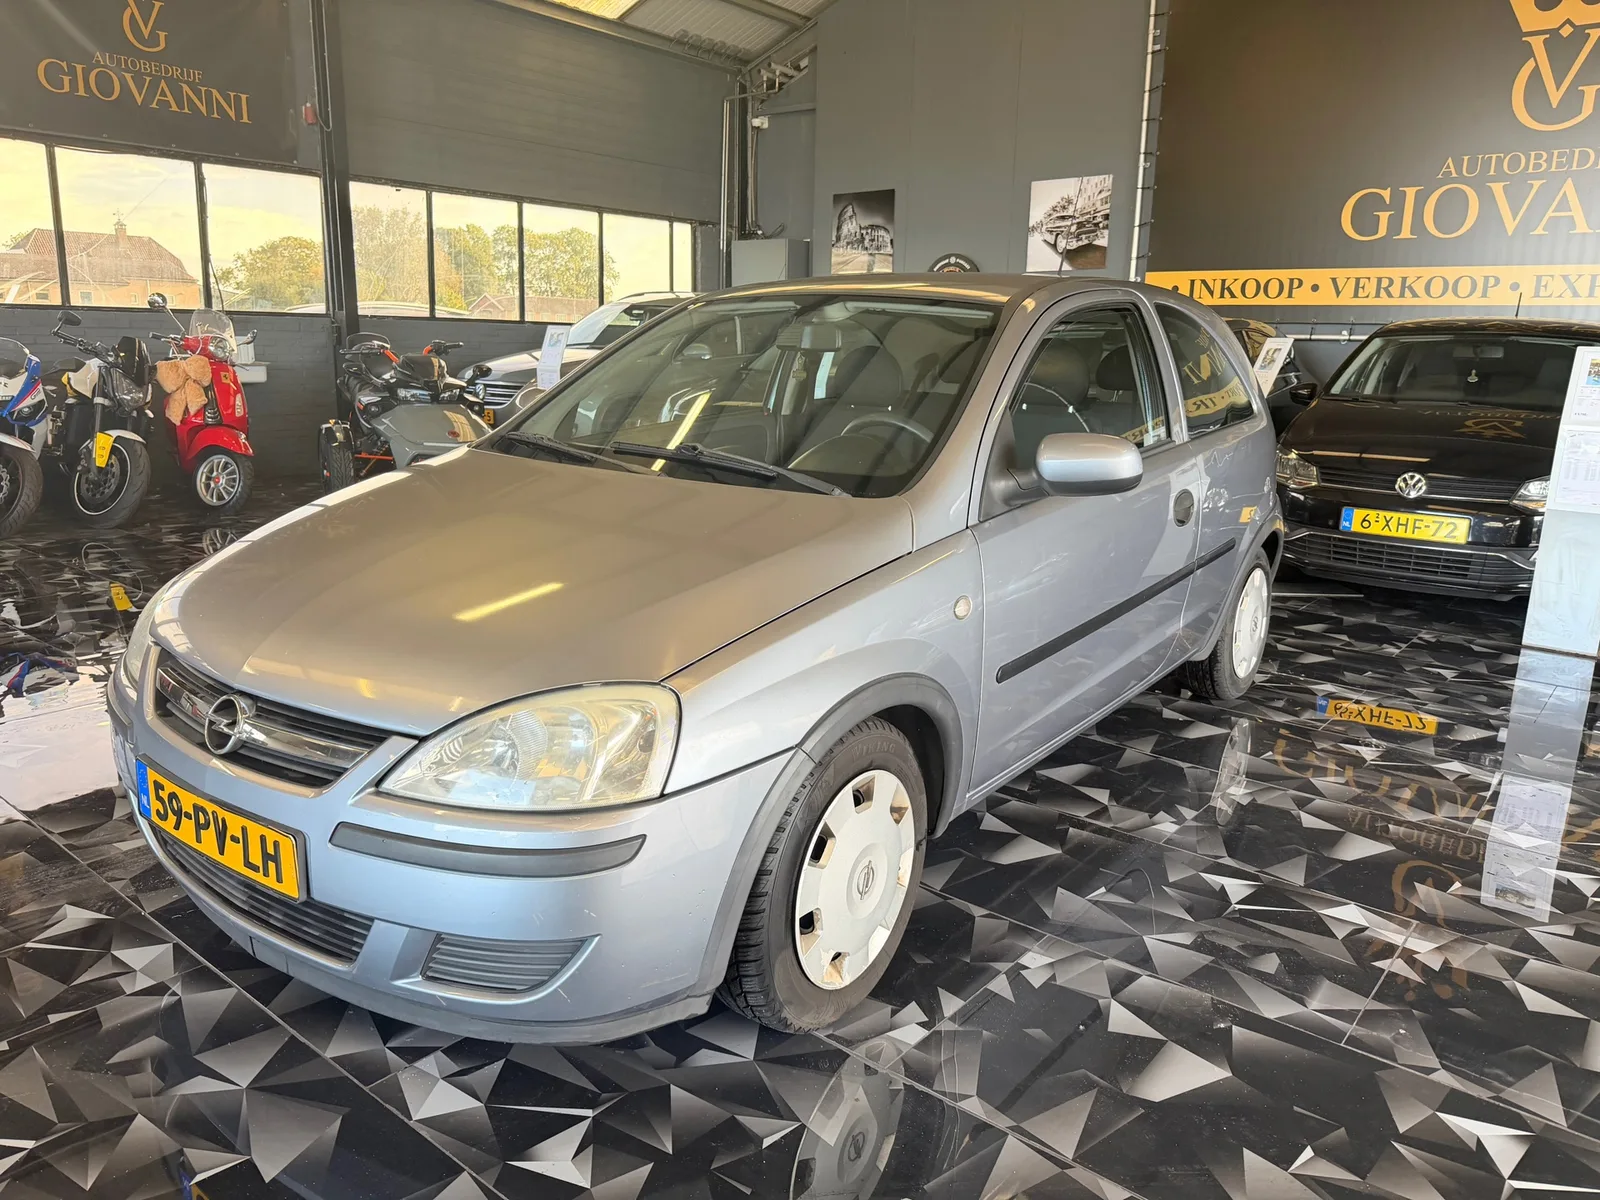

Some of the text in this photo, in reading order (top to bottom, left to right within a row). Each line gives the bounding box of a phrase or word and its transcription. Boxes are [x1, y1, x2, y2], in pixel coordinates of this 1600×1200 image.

[92, 51, 203, 83] AUTOBEDRIJF
[37, 58, 252, 124] GIOVANNI
[1436, 147, 1600, 179] AUTOBED
[1340, 177, 1600, 241] GIOVA
[1188, 277, 1304, 300] INKOOP
[1329, 275, 1501, 299] VERKOOP
[1342, 520, 1351, 529] NL
[140, 793, 150, 809] NL
[152, 779, 284, 884] 59-PV-LH
